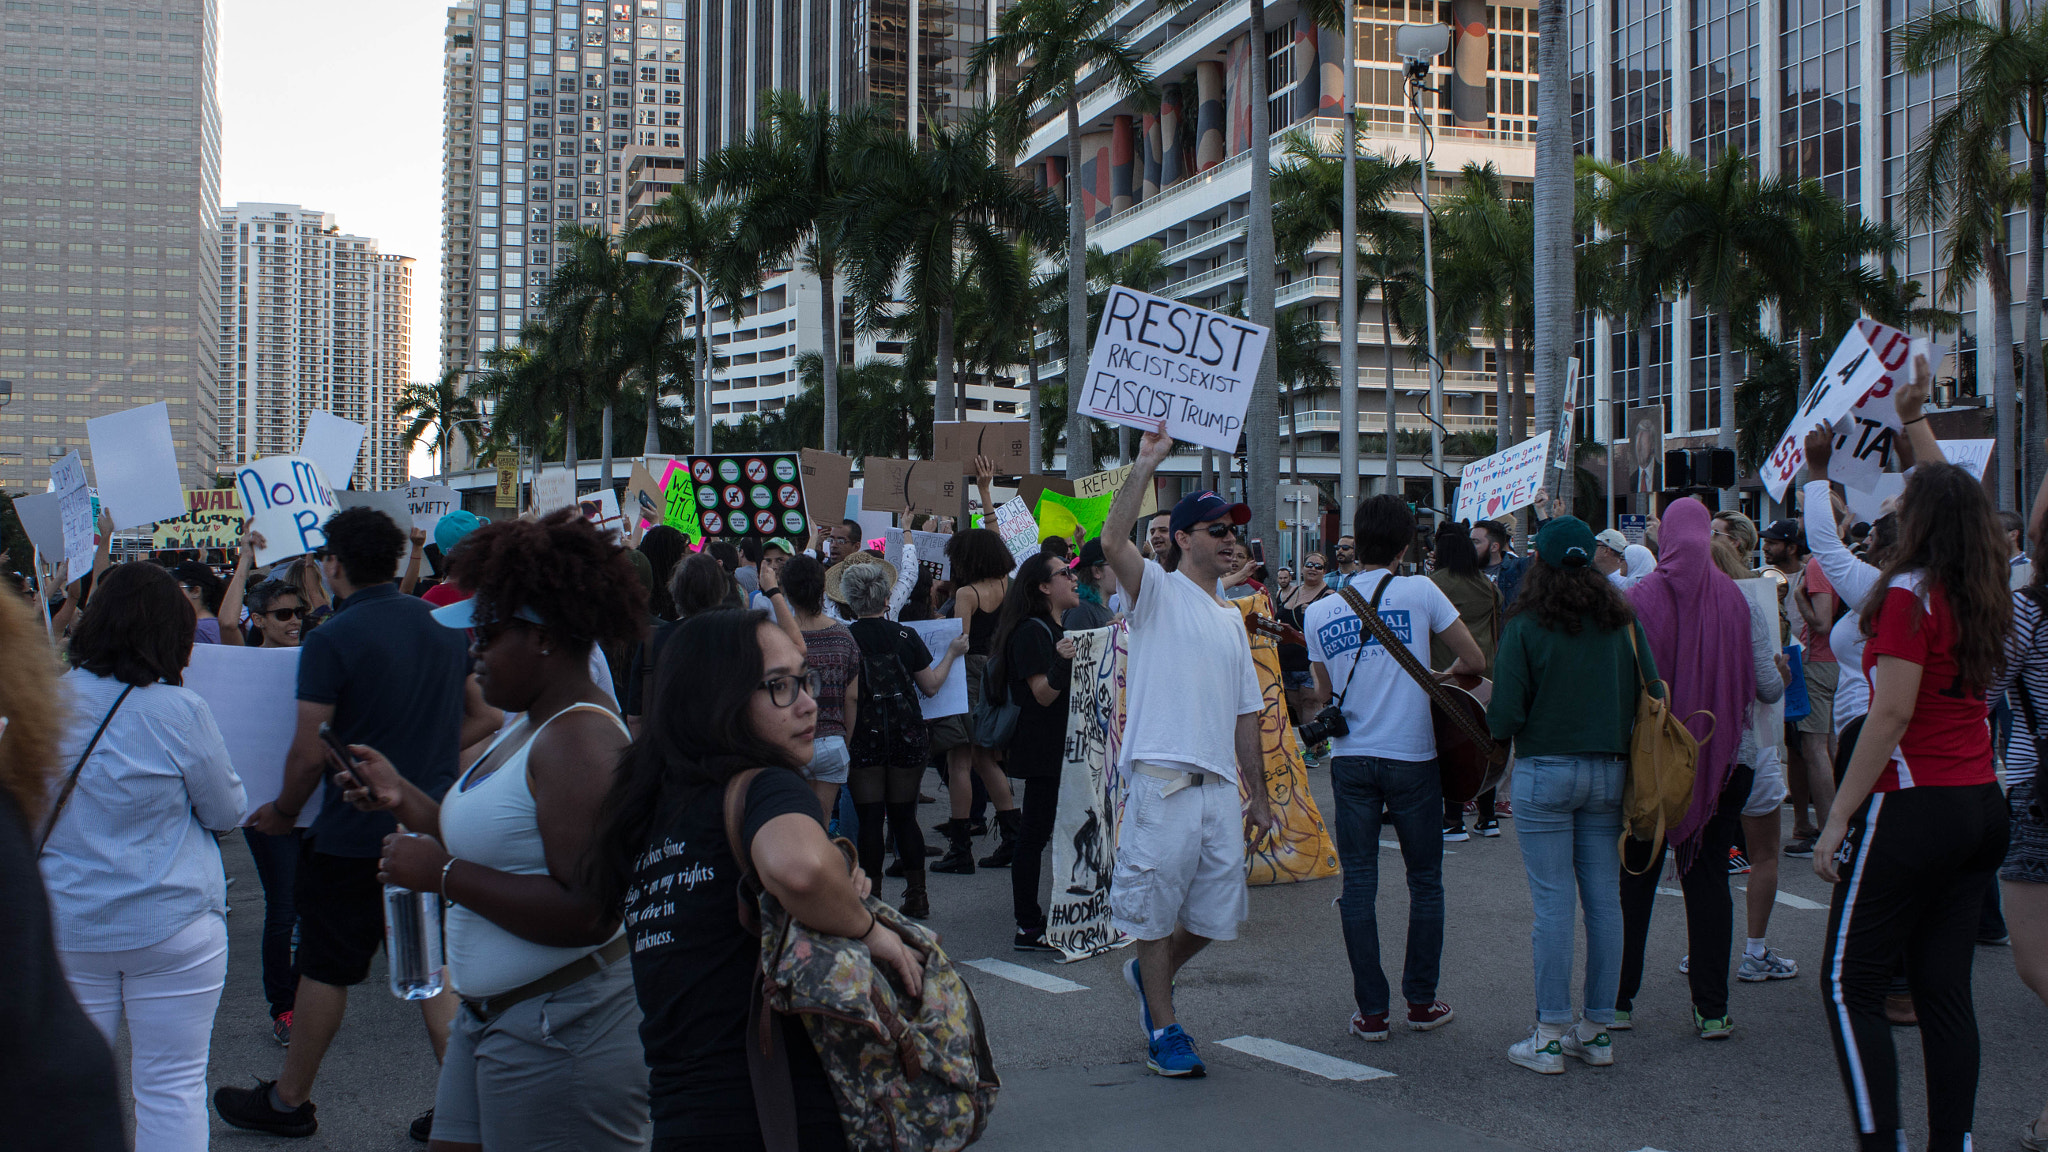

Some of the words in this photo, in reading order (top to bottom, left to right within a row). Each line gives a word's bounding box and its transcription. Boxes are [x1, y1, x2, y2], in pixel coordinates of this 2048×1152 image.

[1105, 291, 1259, 372] RESIST
[1089, 371, 1175, 420] FASCIST
[1180, 395, 1240, 437] TRUMP
[1465, 458, 1496, 478] Uncle
[1499, 451, 1521, 466] Sam
[1521, 443, 1543, 461] gave
[190, 490, 243, 511] WAL
[1461, 496, 1474, 510] It
[1477, 491, 1487, 502] is
[1491, 487, 1503, 496] an
[1505, 478, 1523, 490] act
[1526, 471, 1538, 482] of
[1463, 480, 1480, 492] my
[1320, 613, 1409, 645] POLITAL
[1343, 648, 1386, 662] TODAY
[677, 860, 715, 892] rights
[663, 898, 676, 918] in
